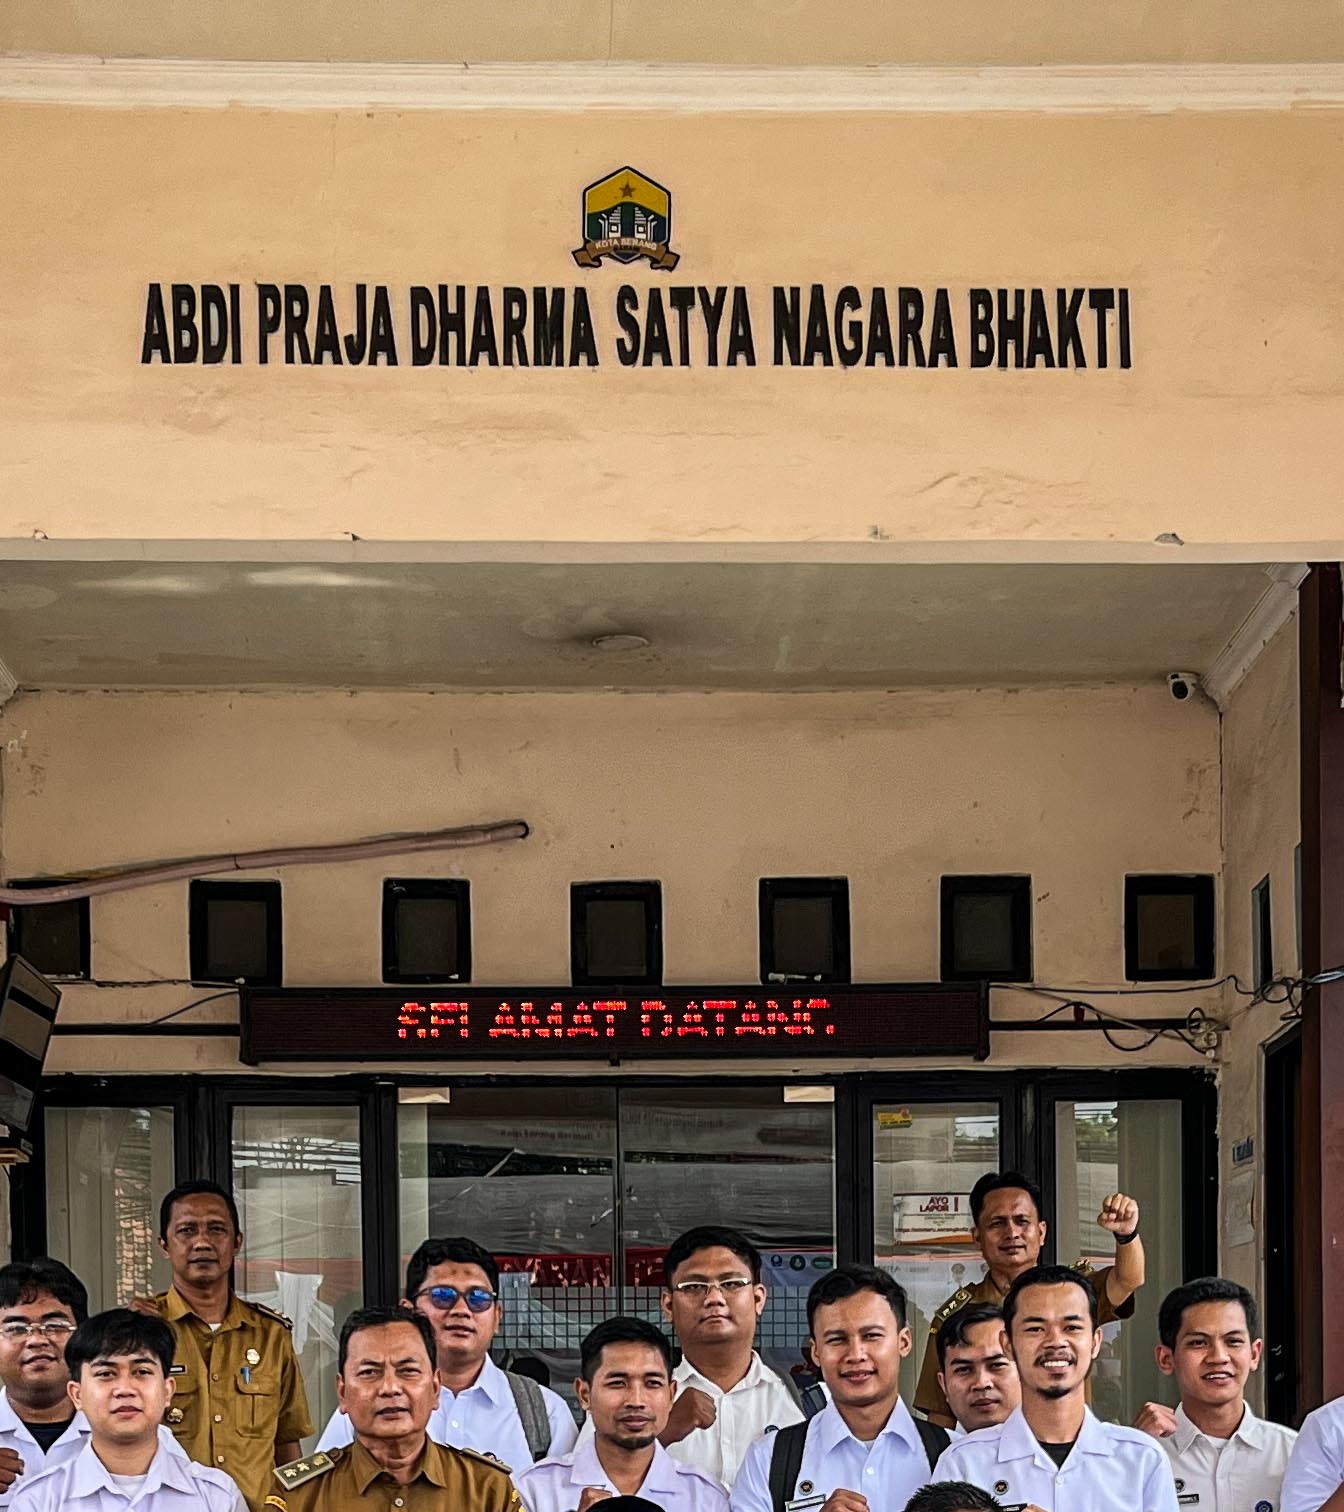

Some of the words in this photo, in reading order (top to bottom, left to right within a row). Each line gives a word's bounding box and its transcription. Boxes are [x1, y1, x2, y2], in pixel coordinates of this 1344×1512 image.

[595, 239, 620, 249] KOTA
[142, 283, 242, 365] ABDI
[257, 283, 399, 367] PRAJA
[410, 284, 600, 367] DHARMA
[616, 284, 757, 367] SATYA
[773, 283, 958, 368] NAGARA
[969, 287, 1132, 370] BHAKTI
